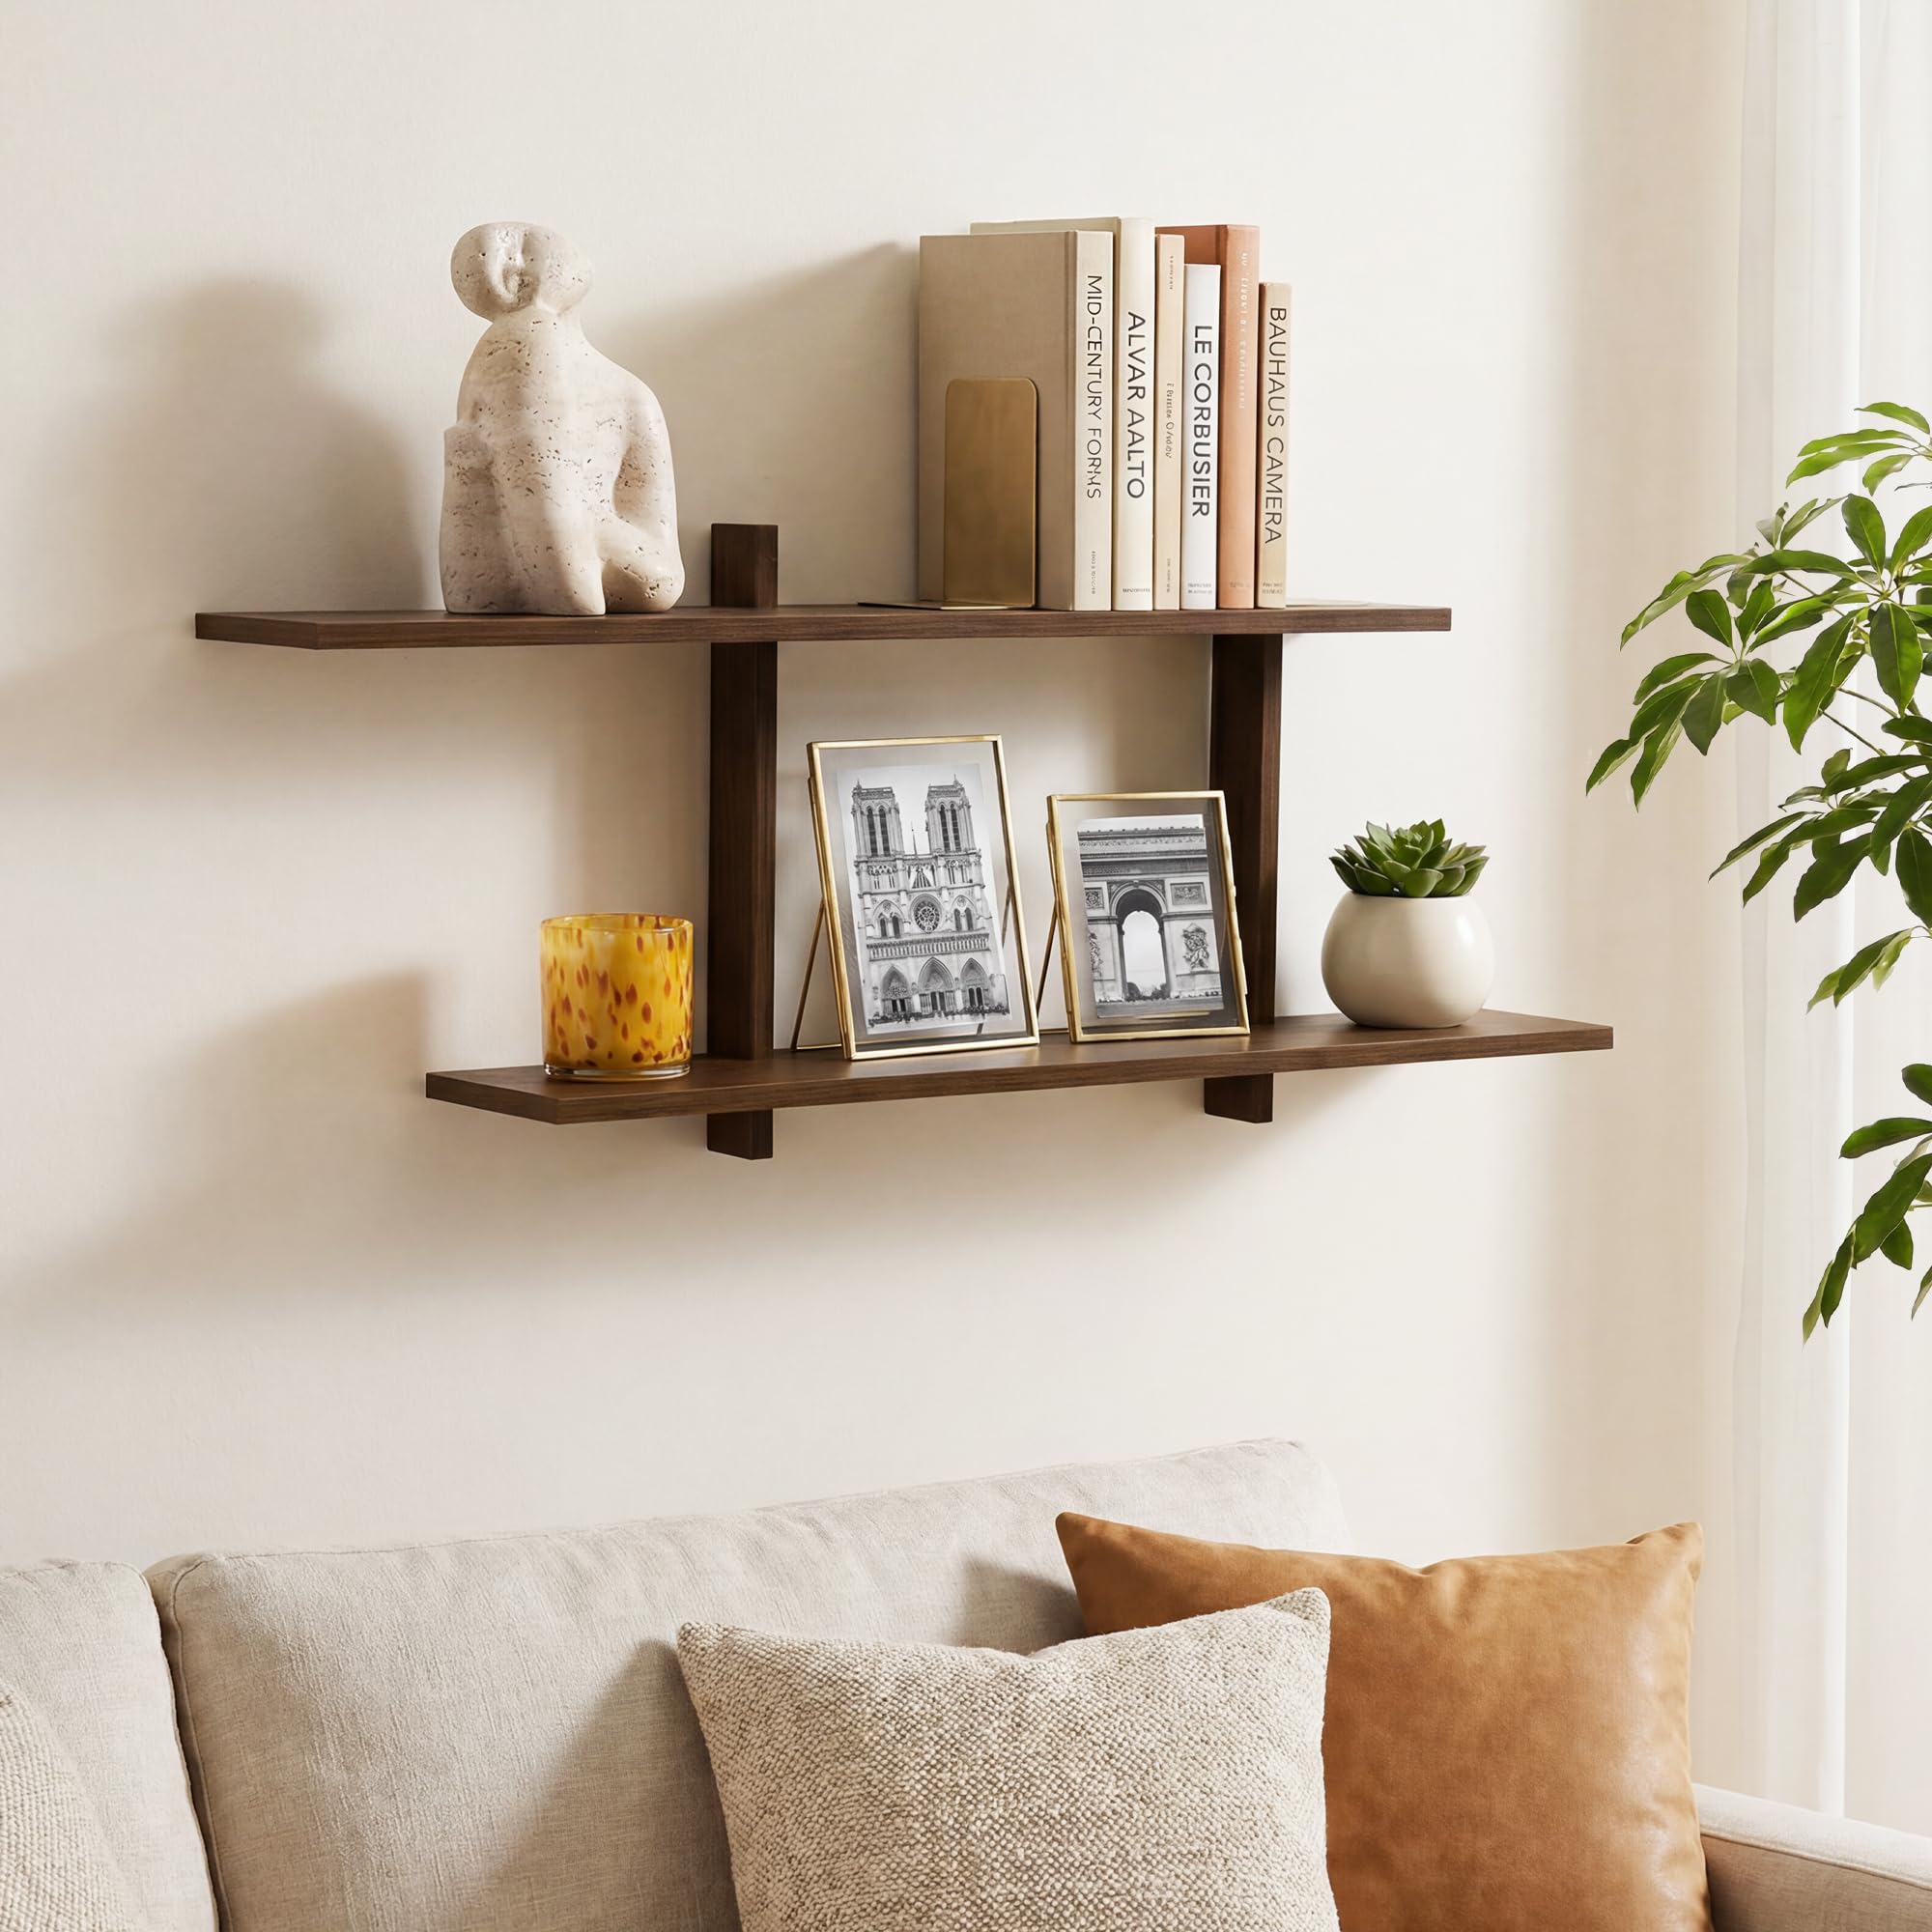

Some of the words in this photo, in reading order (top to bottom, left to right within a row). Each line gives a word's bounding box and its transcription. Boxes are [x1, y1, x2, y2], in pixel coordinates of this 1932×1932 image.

[1087, 275, 1103, 420] MID-CENTURY
[1127, 311, 1147, 401] ALVAR
[1194, 325, 1213, 355] LE
[1267, 307, 1288, 427] BAUHAUS
[1126, 408, 1146, 498] AALTO
[1192, 362, 1212, 518] CORBUSIER
[1264, 437, 1285, 544] CAMERA
